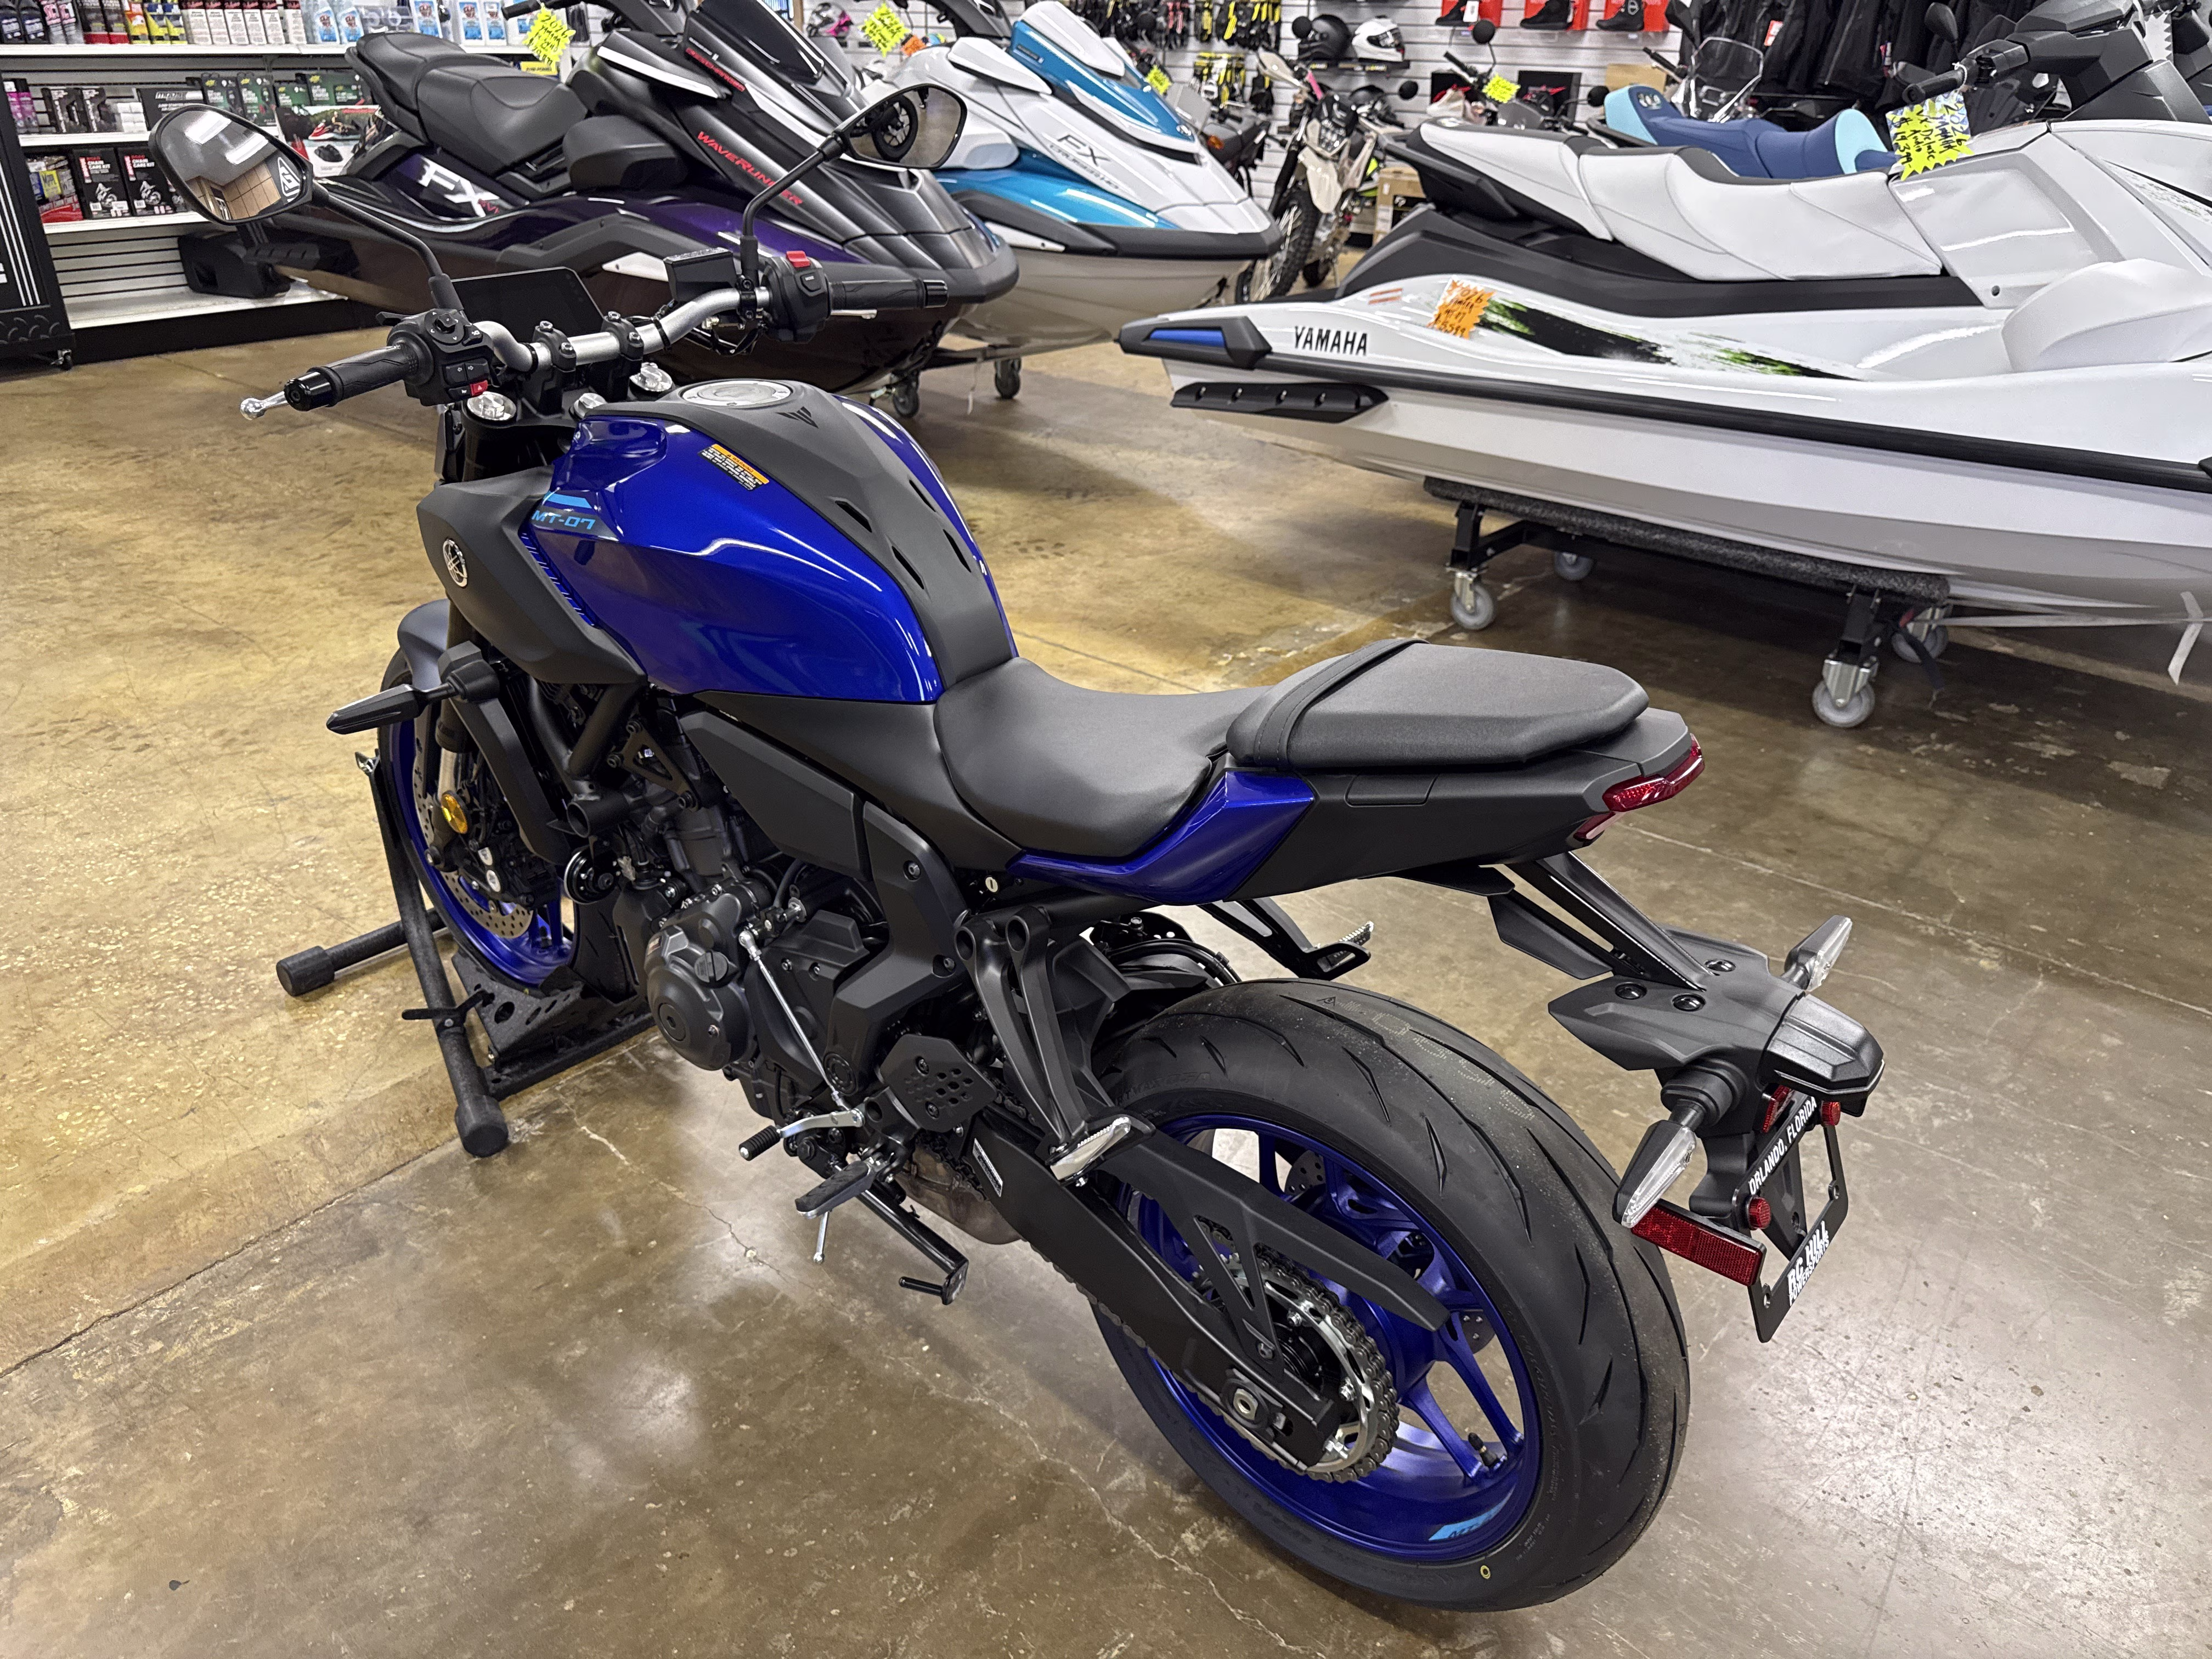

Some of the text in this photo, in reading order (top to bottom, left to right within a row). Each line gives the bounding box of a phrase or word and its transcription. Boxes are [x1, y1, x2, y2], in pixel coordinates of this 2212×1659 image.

[1944, 104, 1967, 146] 2026
[1057, 135, 1111, 166] FX
[418, 156, 500, 218] FX
[1295, 326, 1367, 356] YAMAHA
[732, 456, 754, 473] WARNING
[531, 510, 596, 530] MT-07
[1748, 1096, 1817, 1196] ORLANDO, FLORIDA
[1788, 1220, 1829, 1294] RC HILL
[1789, 1234, 1830, 1307] POWERSPORTS
